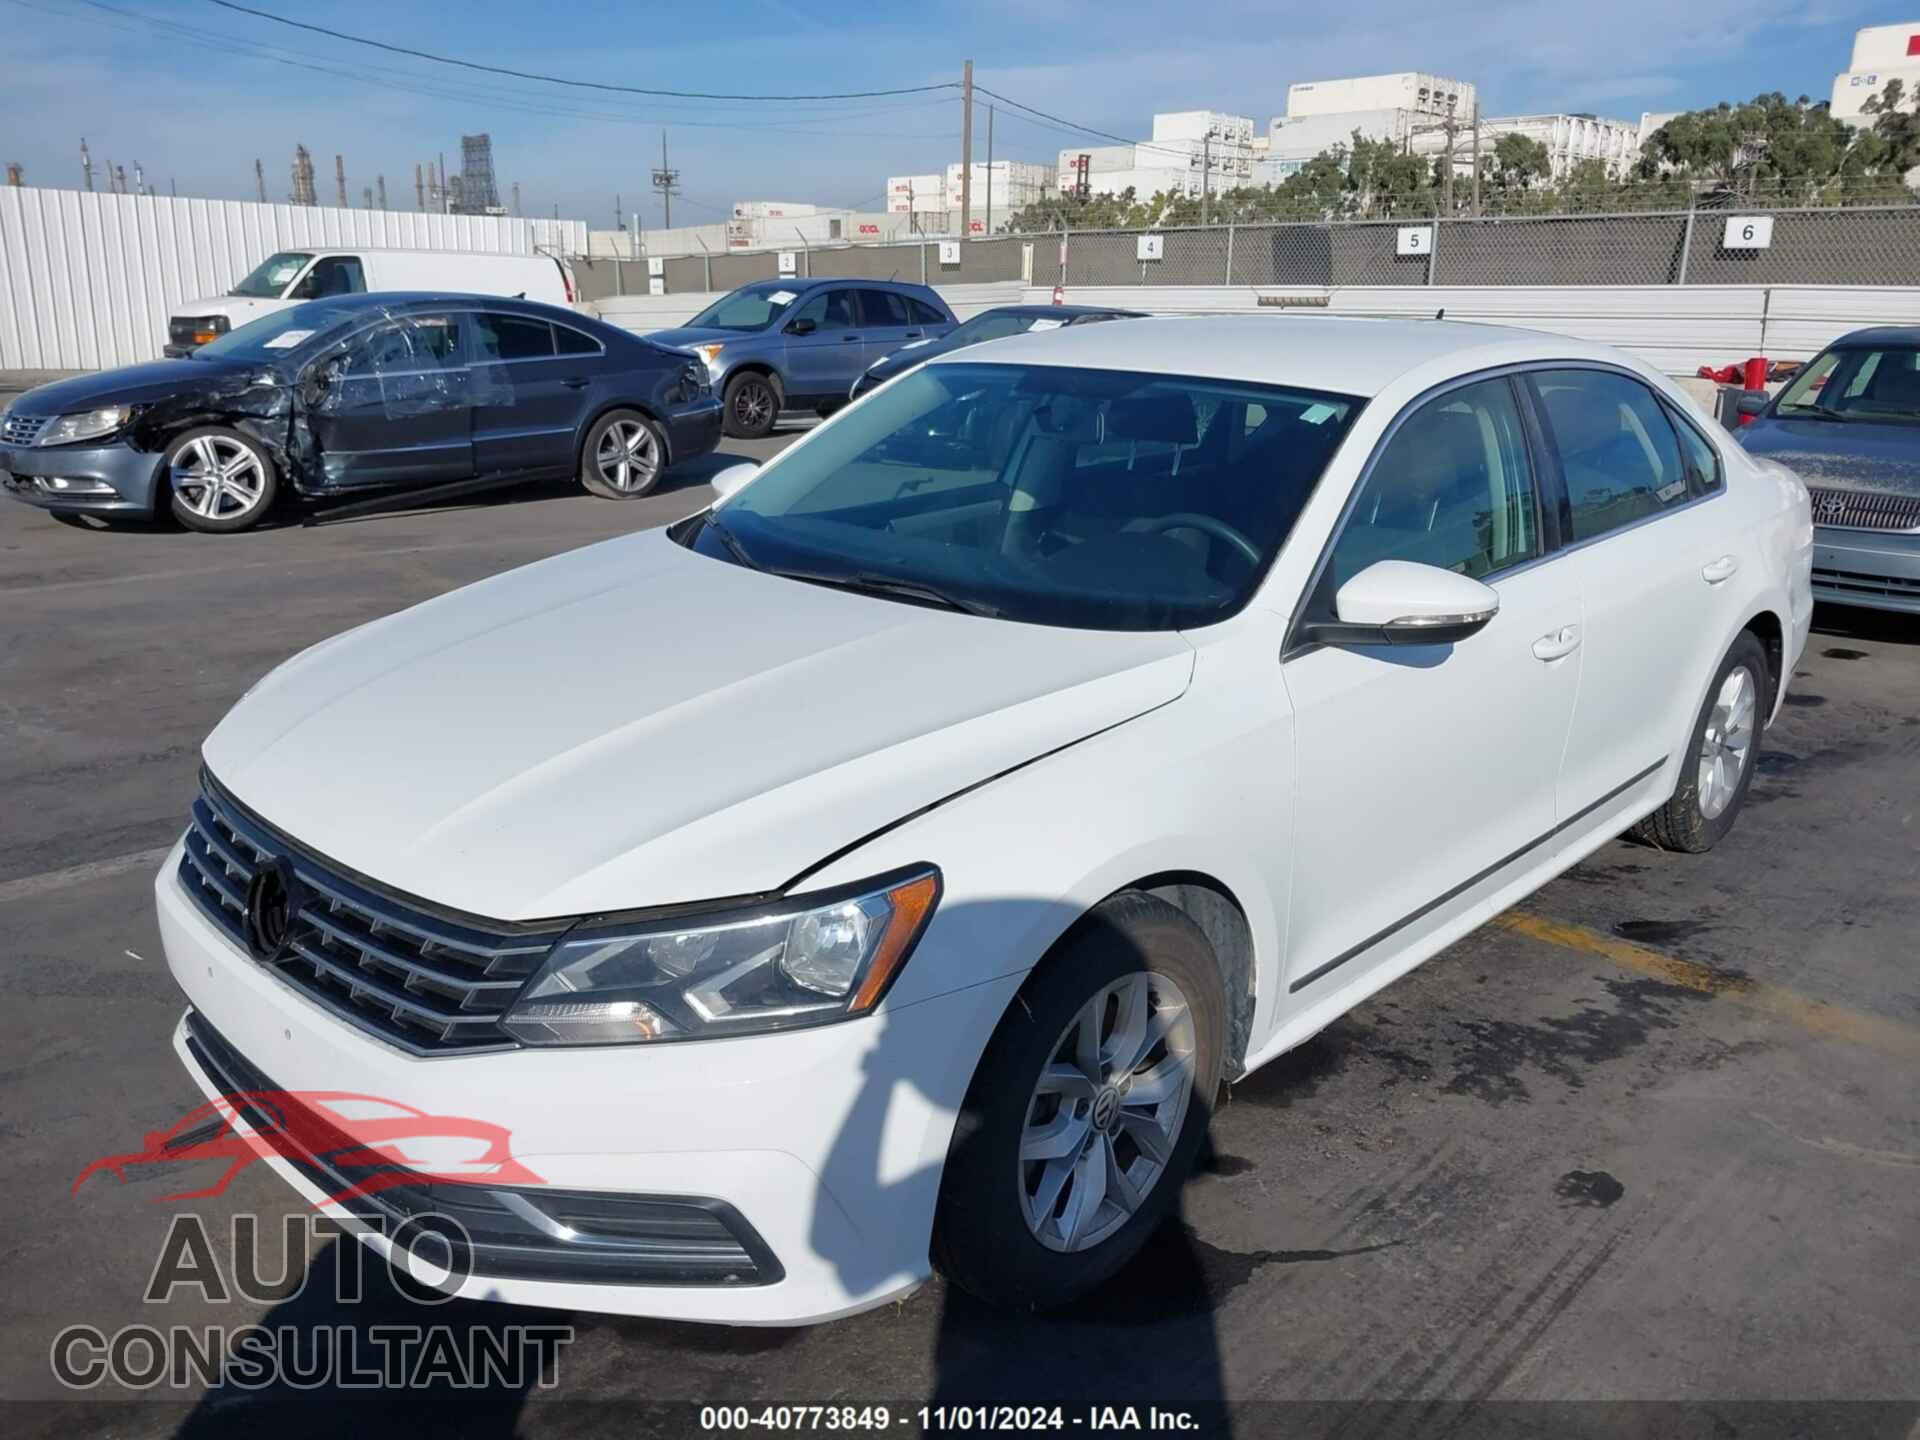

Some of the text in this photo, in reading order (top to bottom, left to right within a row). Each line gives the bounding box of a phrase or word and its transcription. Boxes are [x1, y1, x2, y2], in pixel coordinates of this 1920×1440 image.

[1742, 224, 1754, 241] 6
[1147, 241, 1154, 253] 4
[1410, 234, 1420, 248] 5
